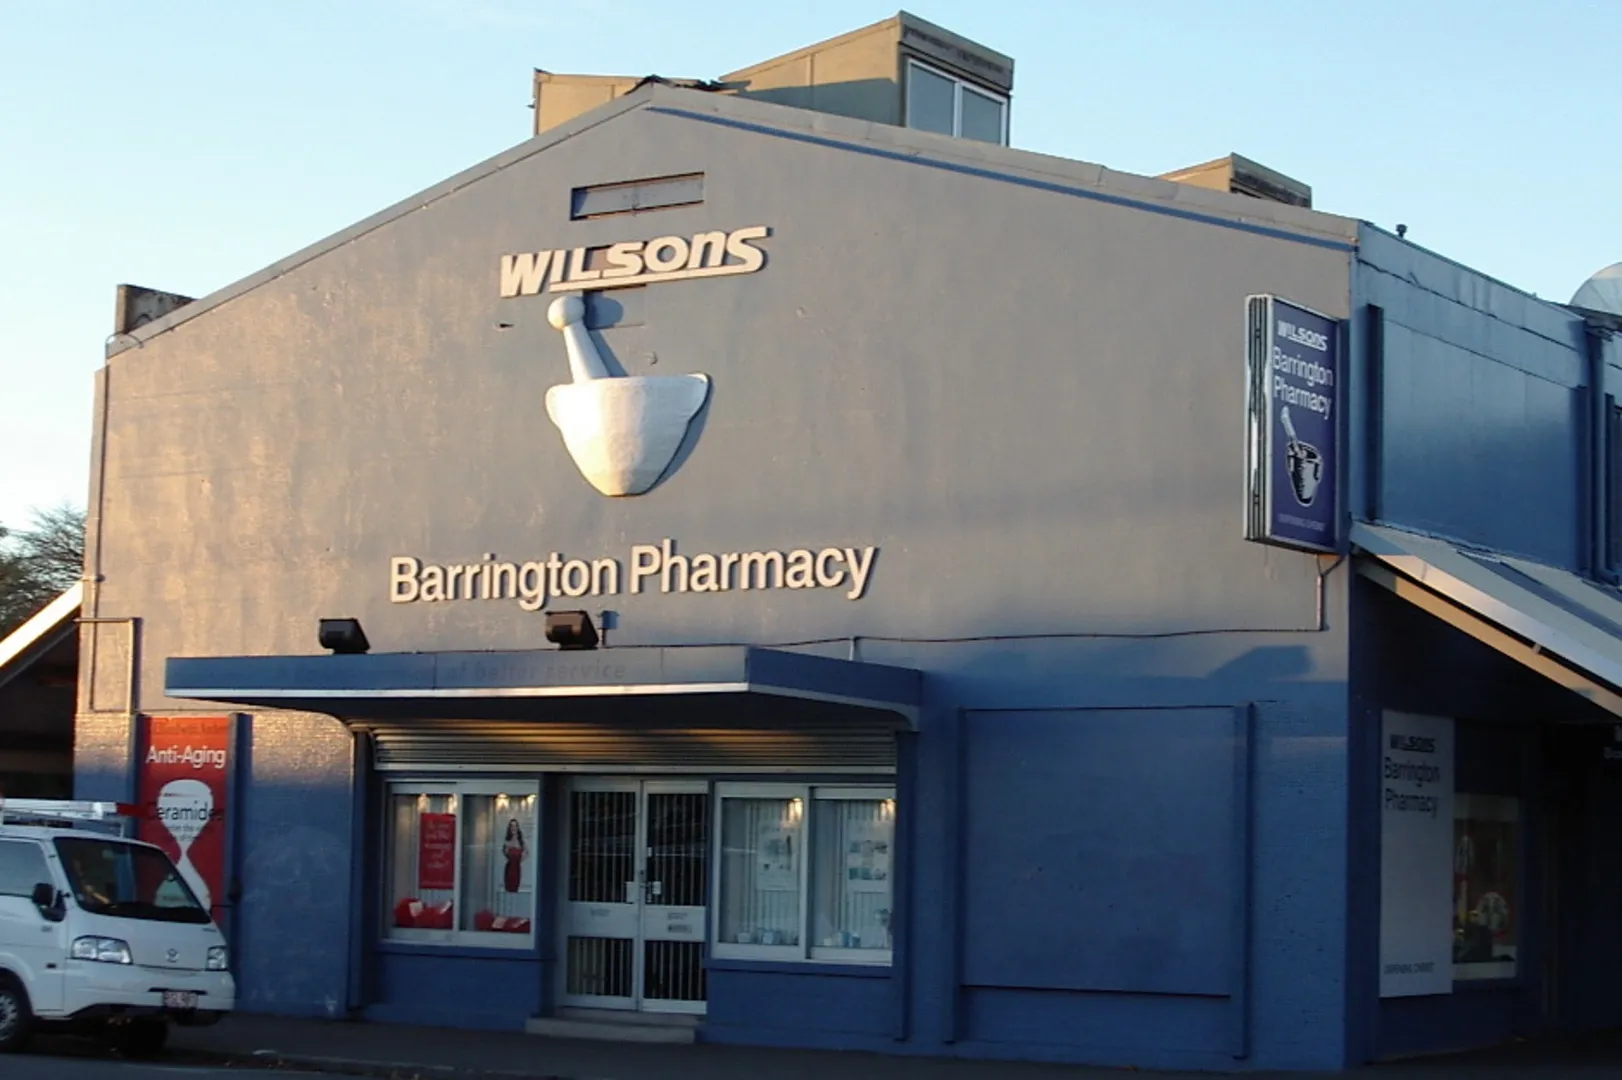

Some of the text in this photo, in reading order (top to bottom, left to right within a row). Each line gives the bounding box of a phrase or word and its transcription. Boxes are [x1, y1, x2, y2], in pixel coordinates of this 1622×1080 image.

[501, 225, 769, 298] WILSONS
[1278, 320, 1328, 351] WILSONS
[1274, 346, 1333, 387] Barrington
[1274, 375, 1331, 420] Pharmacy
[390, 538, 878, 611] Barrington Pharmacy
[545, 659, 627, 681] service
[145, 744, 226, 768] Anti-Aging
[1384, 756, 1440, 788] Barrington
[1384, 788, 1439, 820] Pharmacy
